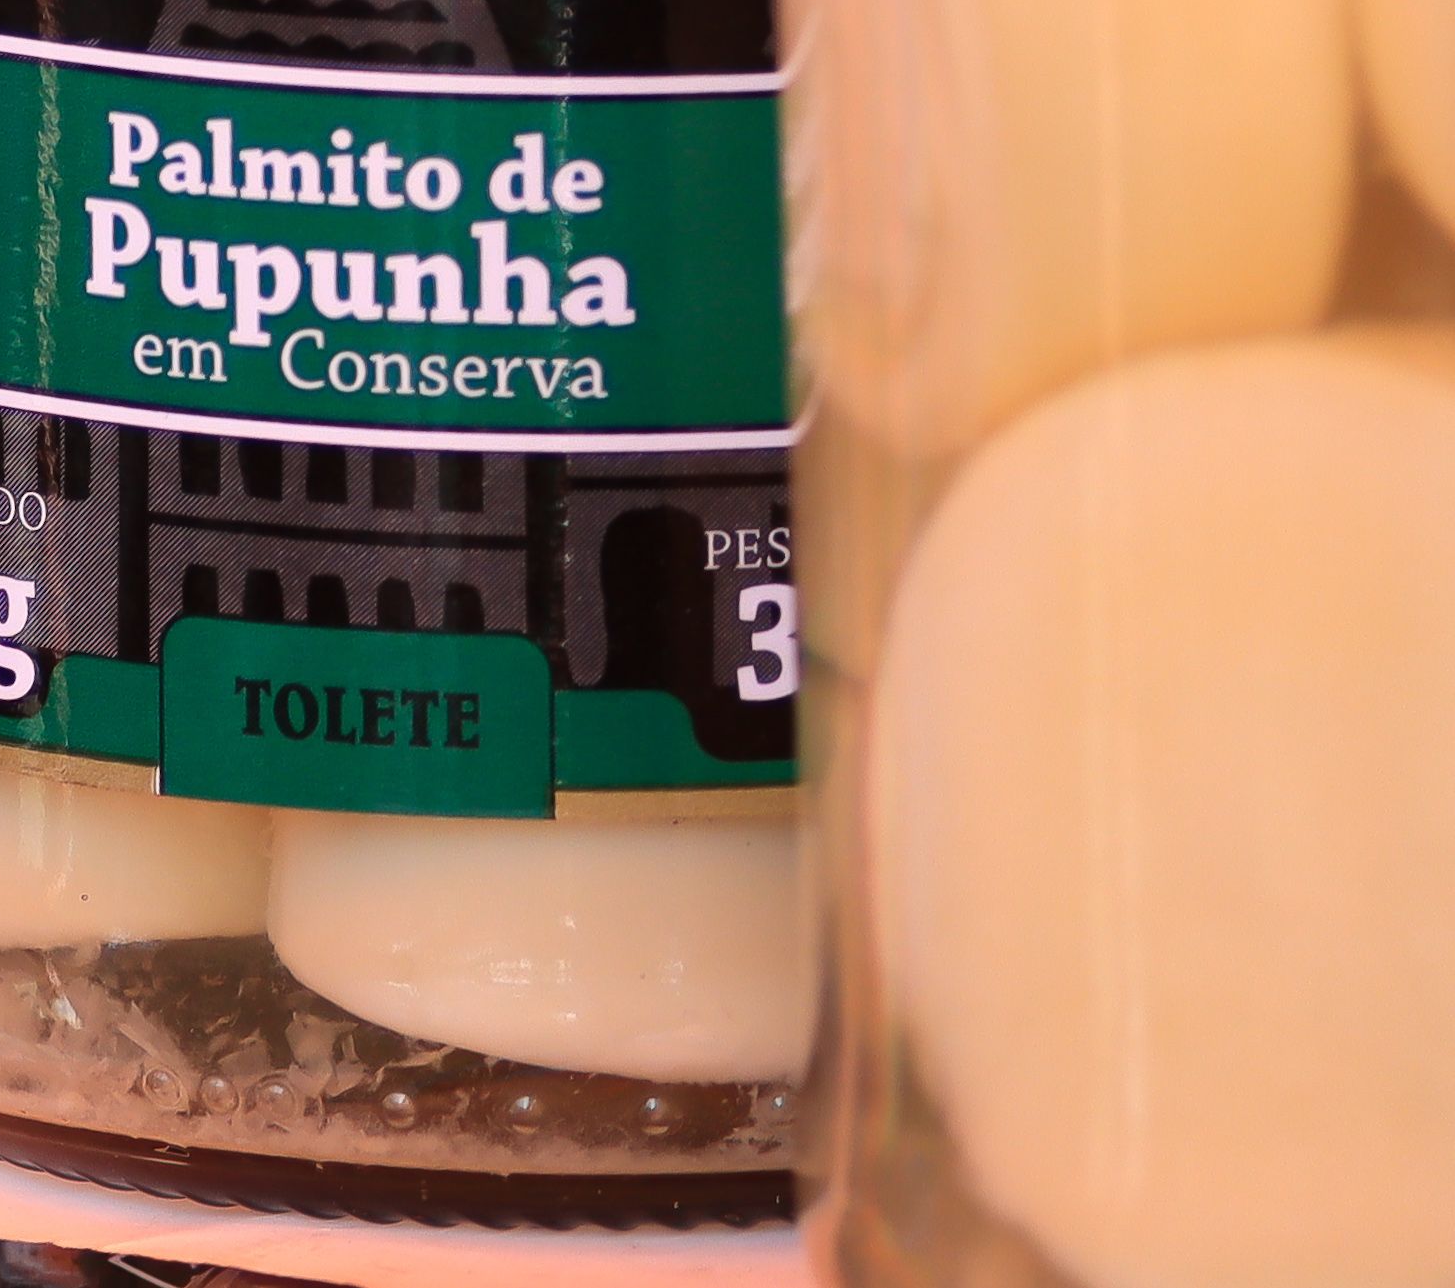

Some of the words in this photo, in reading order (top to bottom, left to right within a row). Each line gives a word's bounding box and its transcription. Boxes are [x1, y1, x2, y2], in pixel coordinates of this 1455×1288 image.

[107, 110, 462, 211] Palmito
[488, 132, 605, 214] de
[84, 196, 637, 347] Pupunha
[132, 332, 229, 384] em
[279, 328, 609, 401] Conserva
[233, 675, 482, 751] TOLETE
